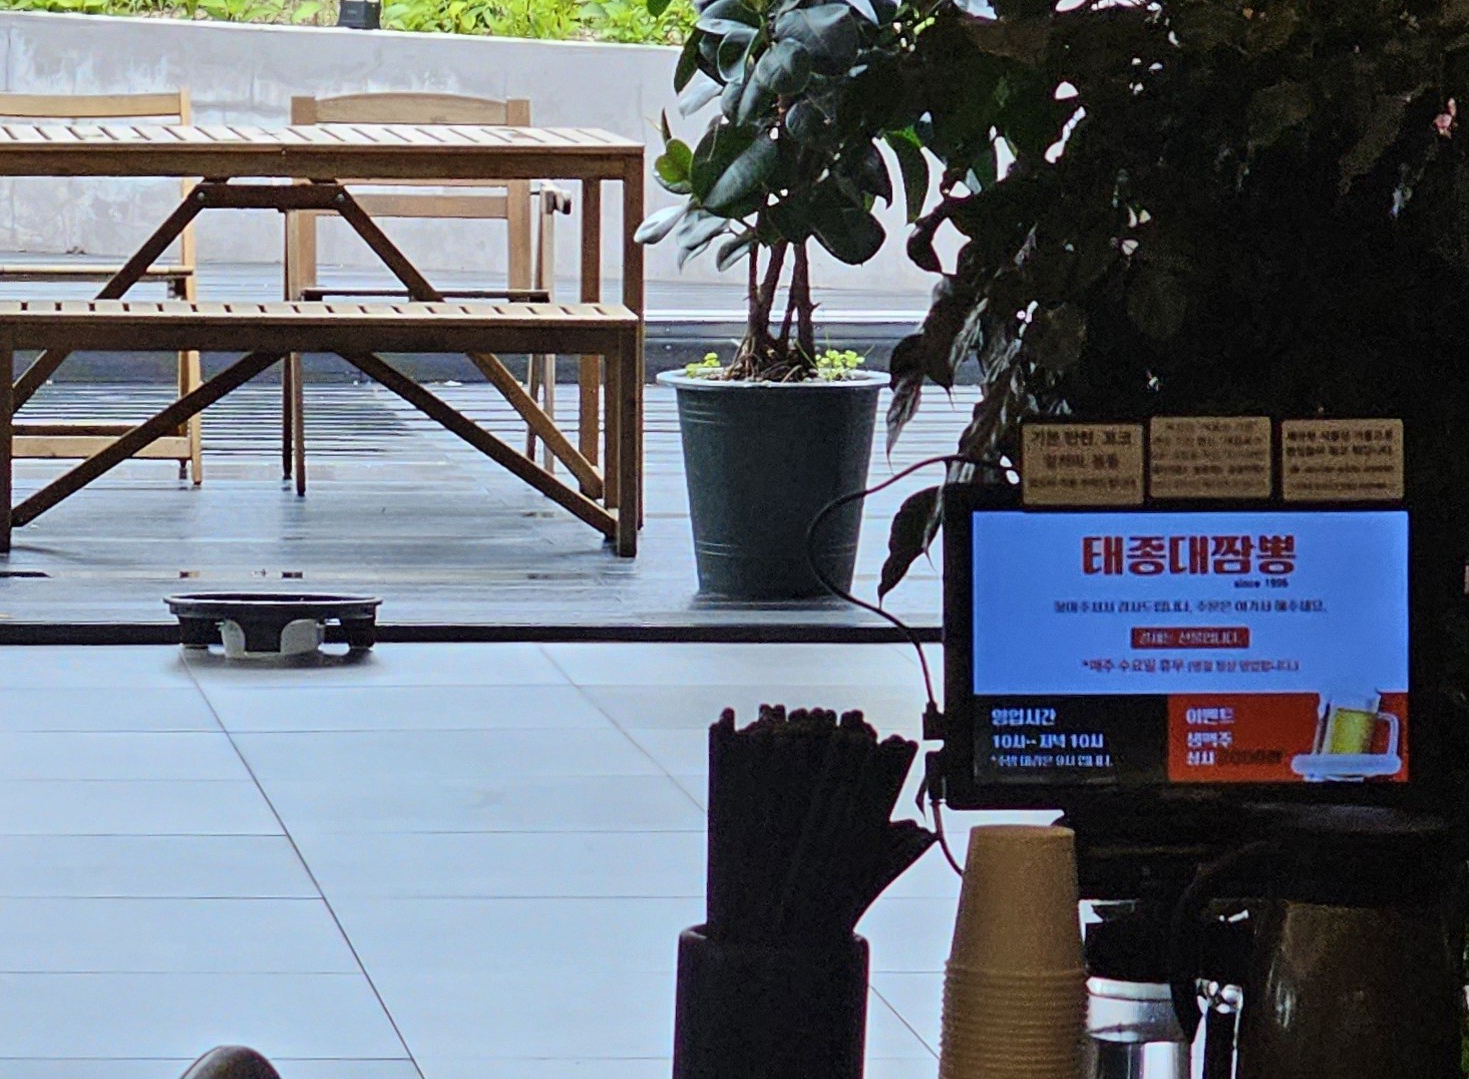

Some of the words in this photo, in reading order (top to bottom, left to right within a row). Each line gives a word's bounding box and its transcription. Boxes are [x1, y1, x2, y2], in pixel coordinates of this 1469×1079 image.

[1082, 535, 1296, 575] 태종대짬뽕
[1119, 659, 1156, 672] 수요일
[1160, 659, 1184, 672] 휴무
[991, 708, 1057, 726] 영업시간
[1186, 708, 1234, 725] 이벤트
[1071, 733, 1104, 749] 10시
[1187, 732, 1233, 748] 생맥주
